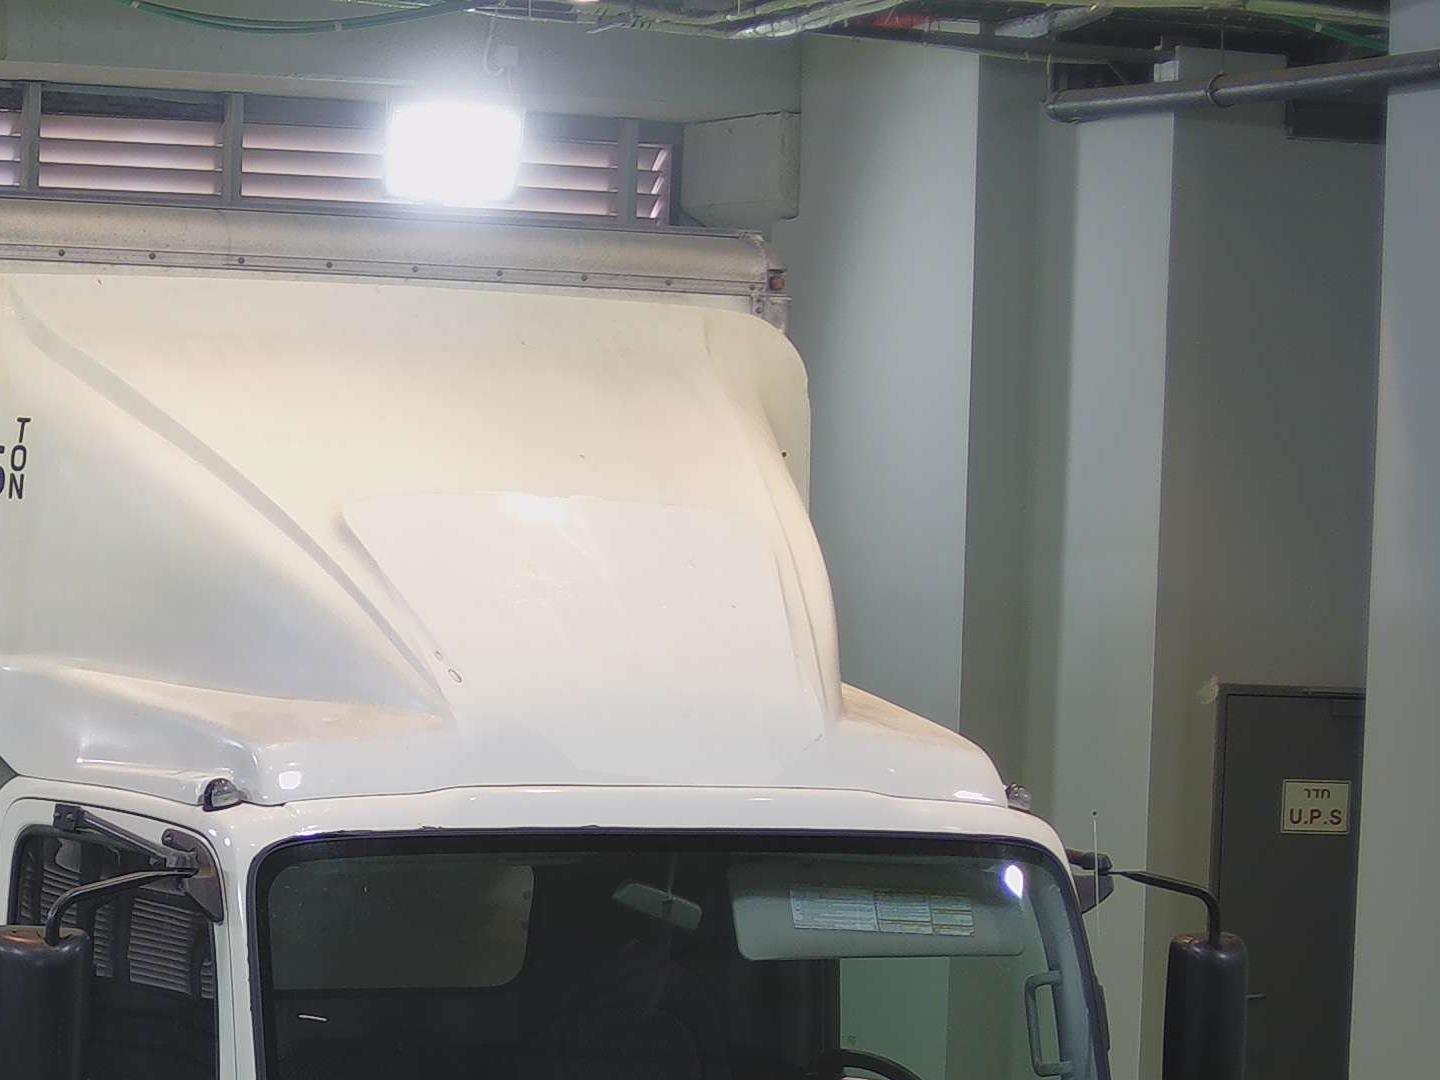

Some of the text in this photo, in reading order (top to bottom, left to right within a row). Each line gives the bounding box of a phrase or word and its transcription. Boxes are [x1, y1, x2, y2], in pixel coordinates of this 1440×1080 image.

[8, 417, 32, 500] TON
[1304, 788, 1331, 801] חדר
[1289, 808, 1343, 826] U.P.S
